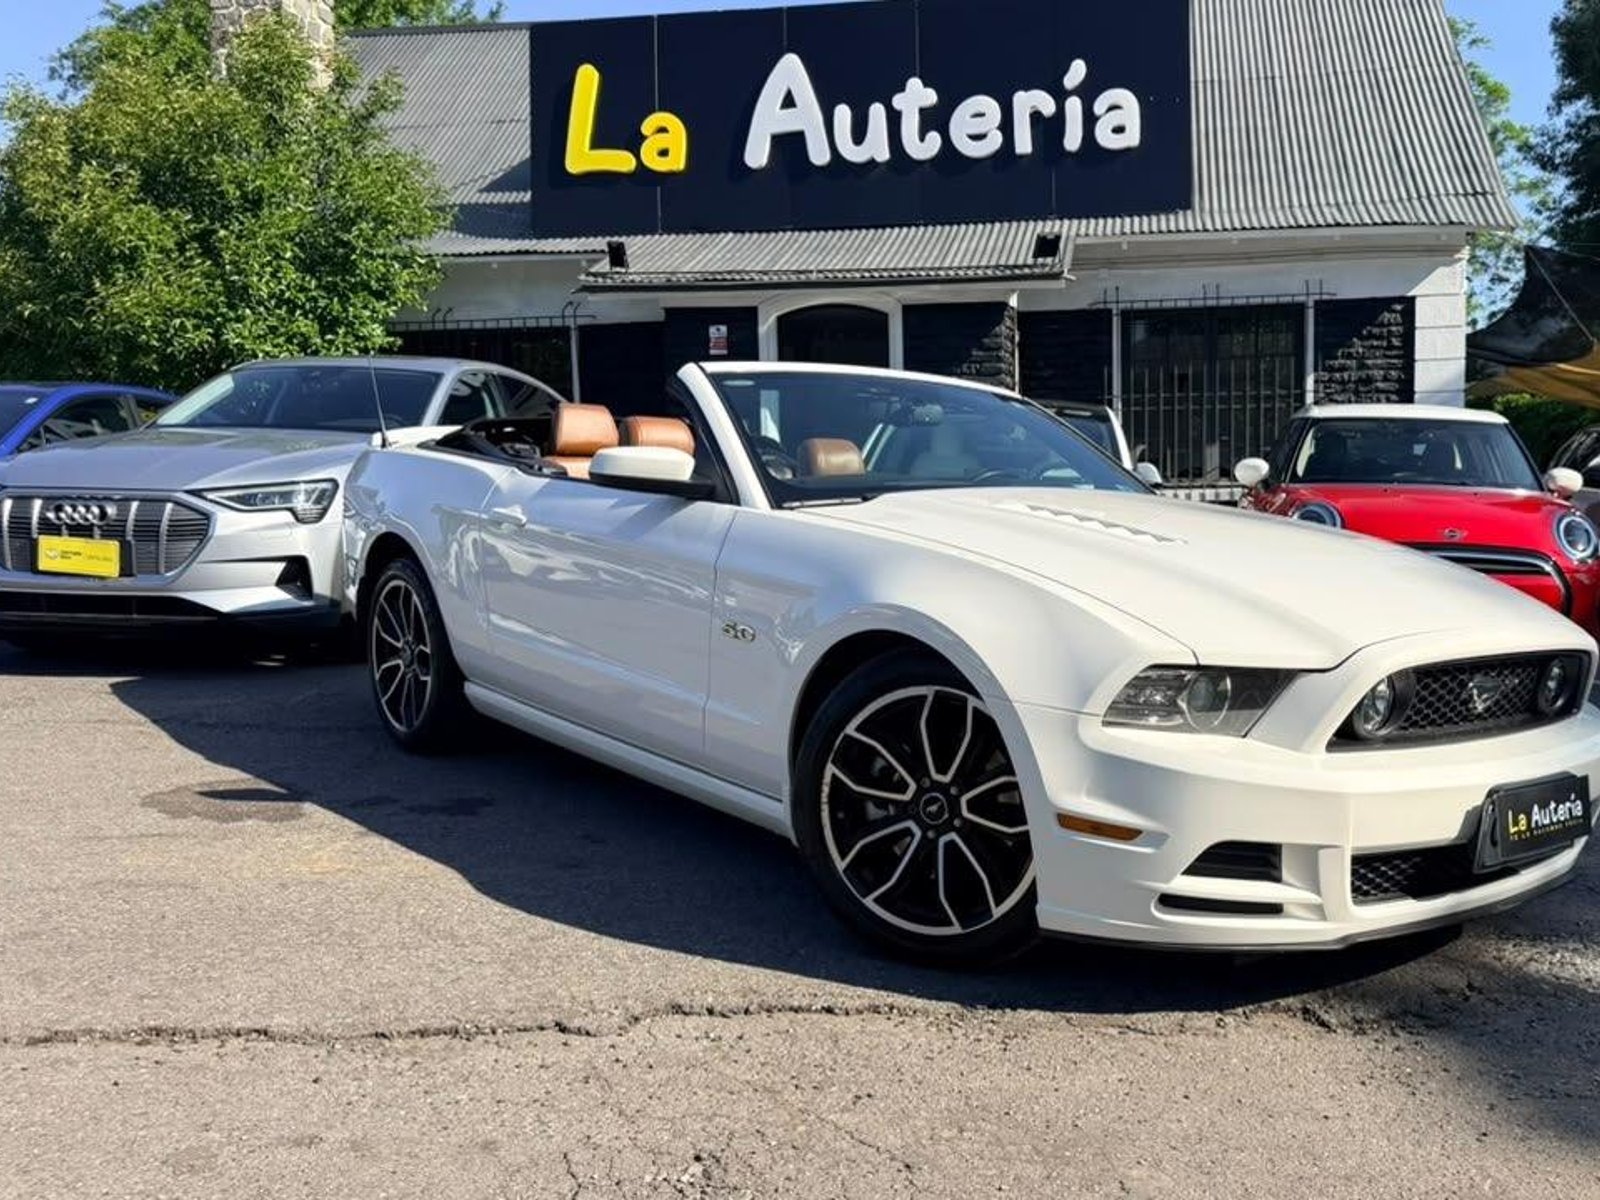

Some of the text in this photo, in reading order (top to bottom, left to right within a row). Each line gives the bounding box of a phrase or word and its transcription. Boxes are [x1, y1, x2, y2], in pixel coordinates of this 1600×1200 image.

[564, 52, 1142, 174] La Autería
[1508, 809, 1527, 834] La
[1531, 793, 1583, 828] Autería
